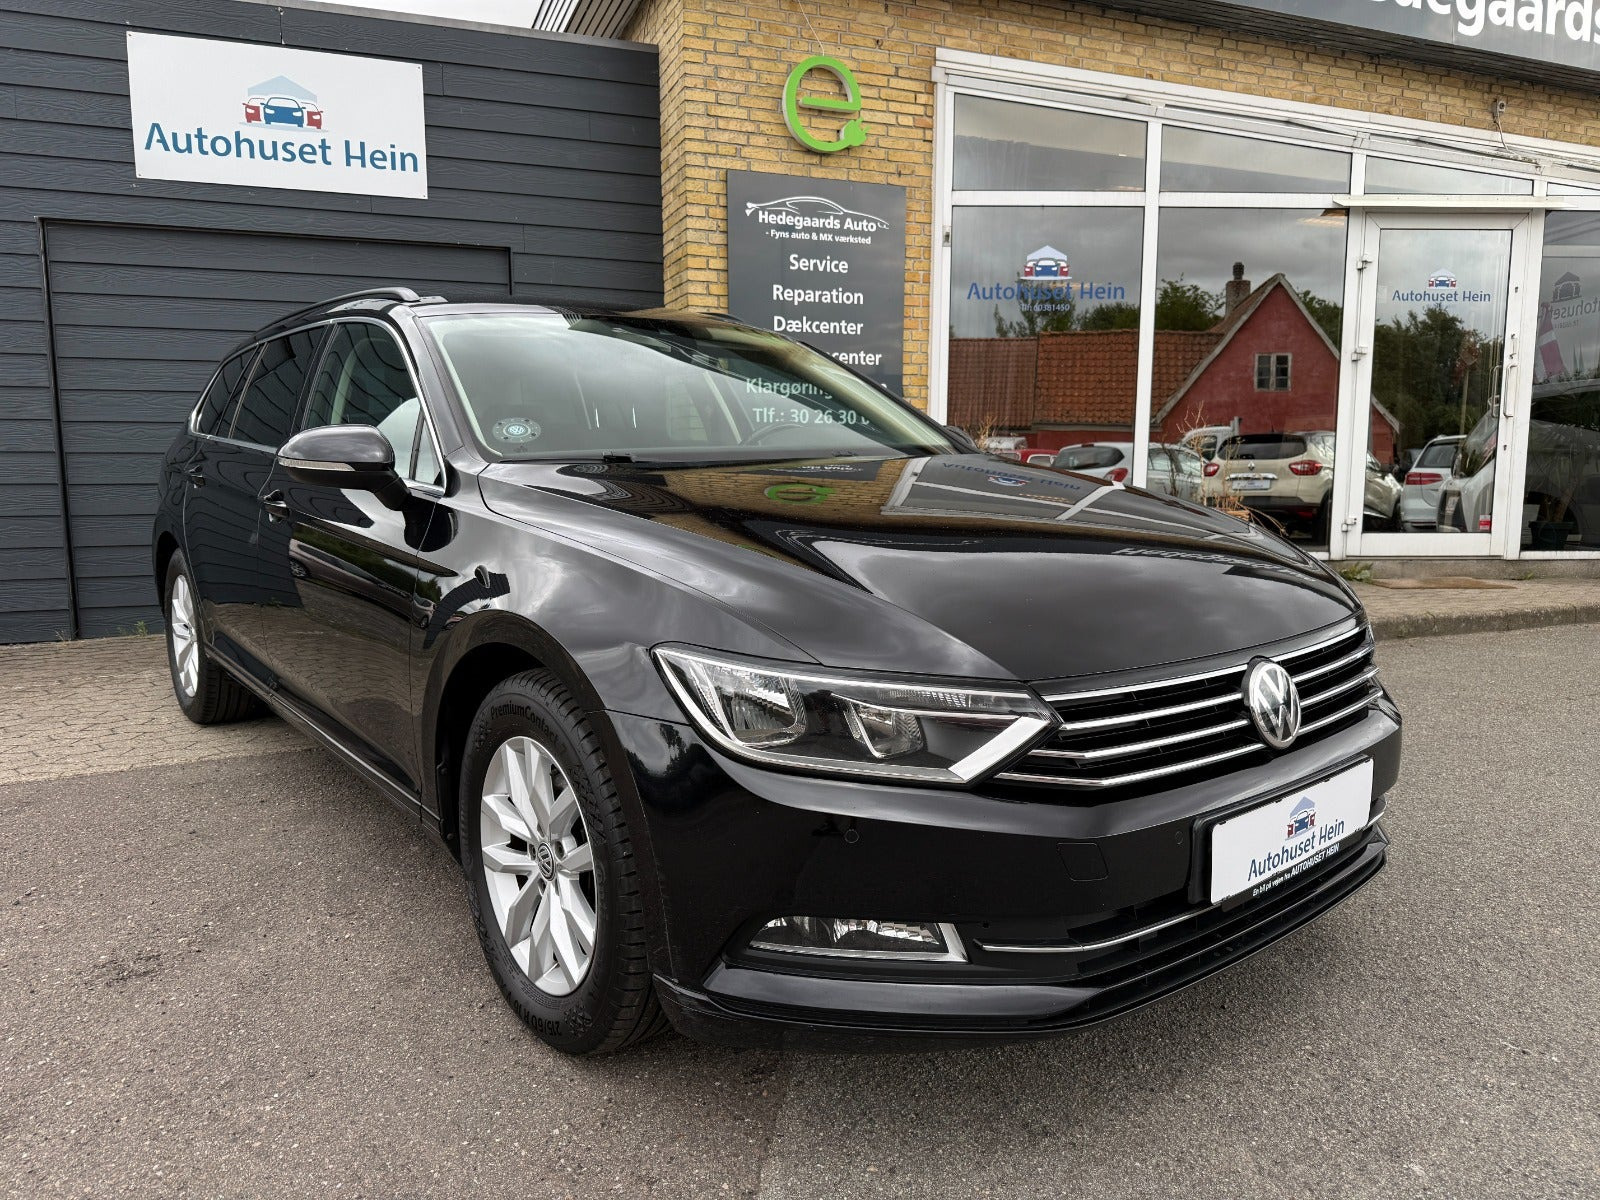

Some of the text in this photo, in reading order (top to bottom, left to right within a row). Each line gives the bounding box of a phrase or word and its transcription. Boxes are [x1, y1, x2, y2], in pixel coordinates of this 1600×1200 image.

[144, 122, 419, 173] Autohuset Hein
[758, 209, 877, 232] Hedegaards Auto
[770, 229, 790, 240] Fyns
[791, 231, 810, 241] auto
[811, 232, 818, 241] &
[819, 233, 833, 242] MX
[834, 234, 872, 245] værksted
[789, 253, 849, 274] Service
[772, 284, 864, 306] Reparation
[967, 282, 1125, 300] Autohuset Hein
[1391, 289, 1491, 303] Autohuset Hein
[773, 315, 864, 335] Dækcenter
[790, 408, 809, 424] 30
[814, 409, 833, 424] 26
[838, 410, 857, 425] 30
[1247, 819, 1345, 882] Autohuset Hein
[1290, 850, 1326, 879] AUTOHUSET
[1326, 842, 1340, 858] HEIN
